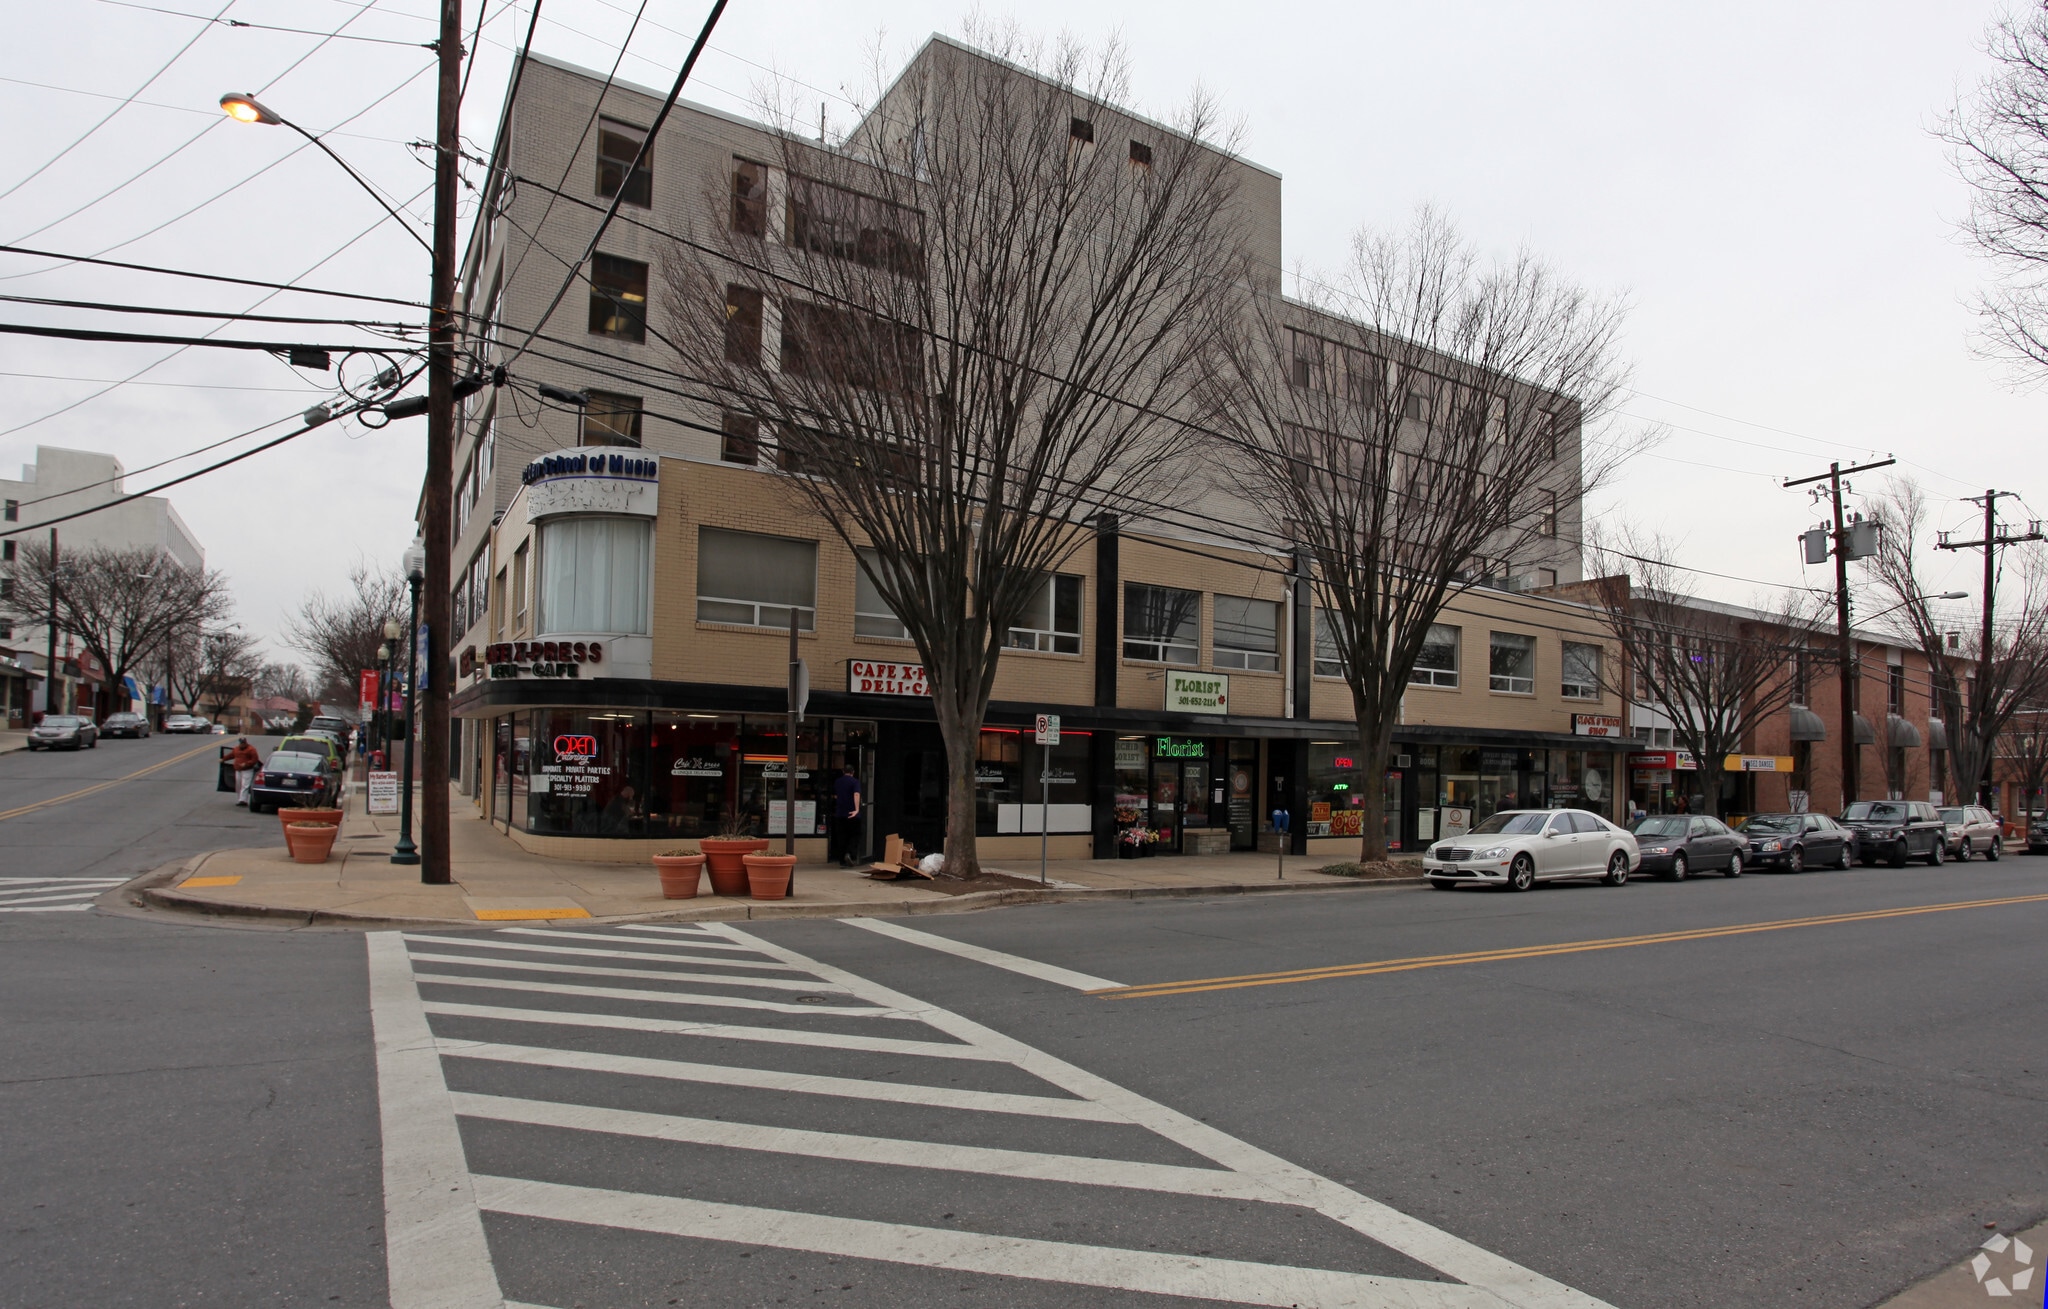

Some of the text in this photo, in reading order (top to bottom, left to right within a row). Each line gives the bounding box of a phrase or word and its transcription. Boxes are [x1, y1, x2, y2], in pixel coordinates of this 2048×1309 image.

[543, 454, 587, 475] School
[589, 454, 605, 473] of
[609, 455, 657, 477] Music
[853, 662, 896, 679] CAFE
[1175, 678, 1221, 694] FLORIST
[554, 735, 595, 755] OPEN
[1156, 736, 1204, 757] Florist
[574, 775, 600, 784] PLATTERS
[587, 767, 611, 775] PARTIES
